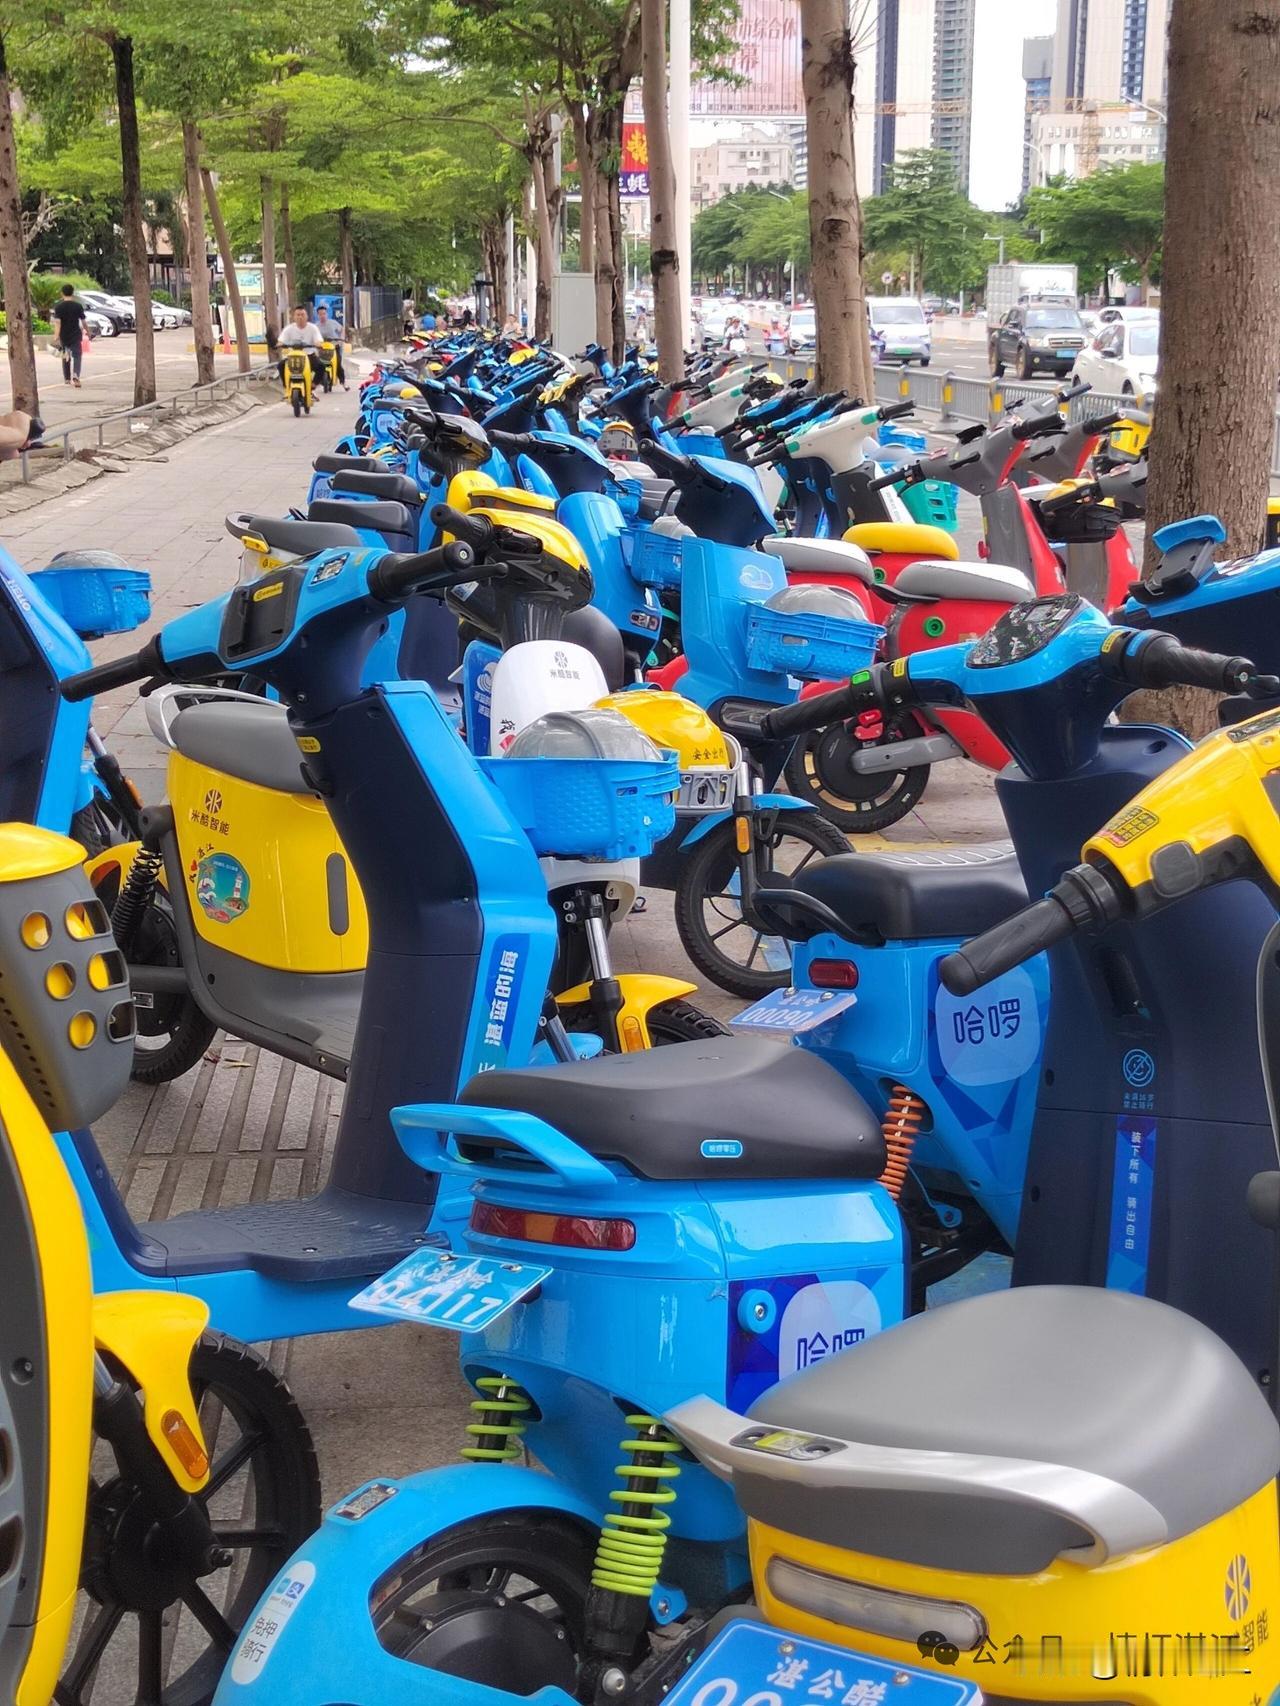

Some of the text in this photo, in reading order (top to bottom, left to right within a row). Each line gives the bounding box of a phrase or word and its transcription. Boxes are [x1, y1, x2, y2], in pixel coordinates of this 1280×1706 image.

[190, 808, 231, 835] 米酷智能
[953, 998, 1021, 1045] 哈啰
